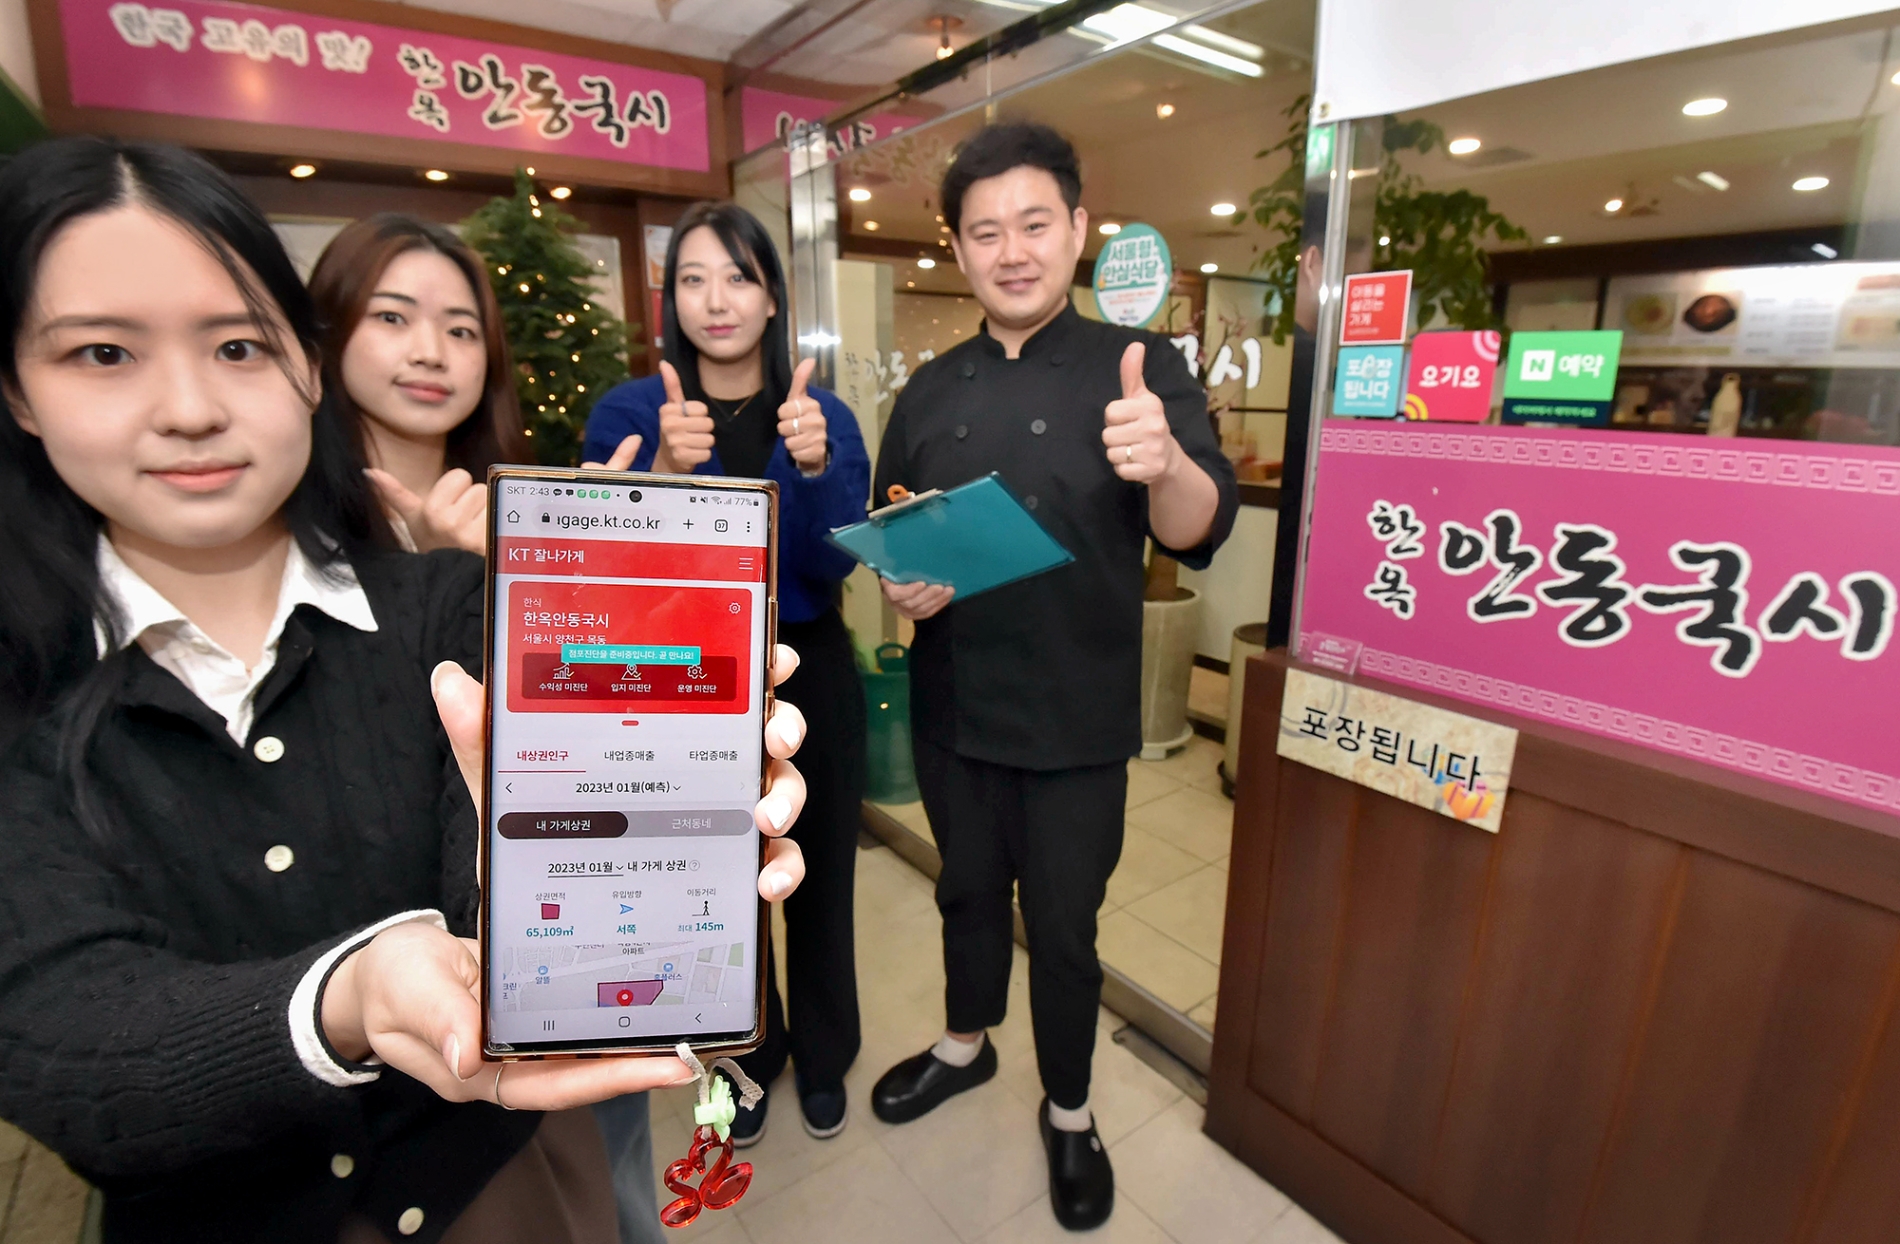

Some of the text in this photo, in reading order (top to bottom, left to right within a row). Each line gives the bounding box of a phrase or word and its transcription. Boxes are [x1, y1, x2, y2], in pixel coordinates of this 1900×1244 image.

[201, 17, 309, 66] 고유의
[315, 31, 372, 73] 맛!
[452, 53, 670, 148] 안동국시
[1109, 236, 1155, 261] 서울형
[1102, 257, 1161, 283] 안심식당
[1558, 353, 1605, 378] 예약
[1419, 365, 1481, 388] 요기요
[1344, 380, 1390, 400] 됩니다
[507, 486, 550, 496] SKT 2:43
[735, 497, 752, 506] 77%
[508, 548, 584, 564] KT 잘나가게
[1439, 509, 1896, 678] 안동국시
[523, 597, 542, 608] 한식
[523, 611, 609, 628] 한옥안동국시
[523, 633, 607, 645] 서울시 양천구 목동
[569, 649, 607, 659] 점포진단을
[609, 650, 658, 660] 준비중입니다.
[659, 651, 667, 659] 곧
[539, 683, 588, 692] 수익성 미진단
[611, 684, 651, 692] 입지 미진단
[677, 684, 717, 693] 운영 미진단
[1299, 705, 1481, 792] 포장됩니다
[516, 750, 569, 762] 내상권인구
[604, 750, 655, 762] 내업종매출
[689, 750, 738, 762] 타업종매출
[575, 781, 670, 794] 2023년 01월(예측)
[536, 819, 591, 831] 내 가게상권
[671, 818, 711, 829] 근처동네
[548, 860, 686, 874] 2023년 01월 내 가게 상권
[535, 892, 566, 901] 상권면적
[612, 890, 642, 899] 유입방향
[686, 888, 716, 897] 이동거리
[616, 924, 637, 935] 서쪽
[695, 921, 724, 932] 145m
[622, 947, 645, 955] 아파트
[535, 976, 551, 985] 알뜰
